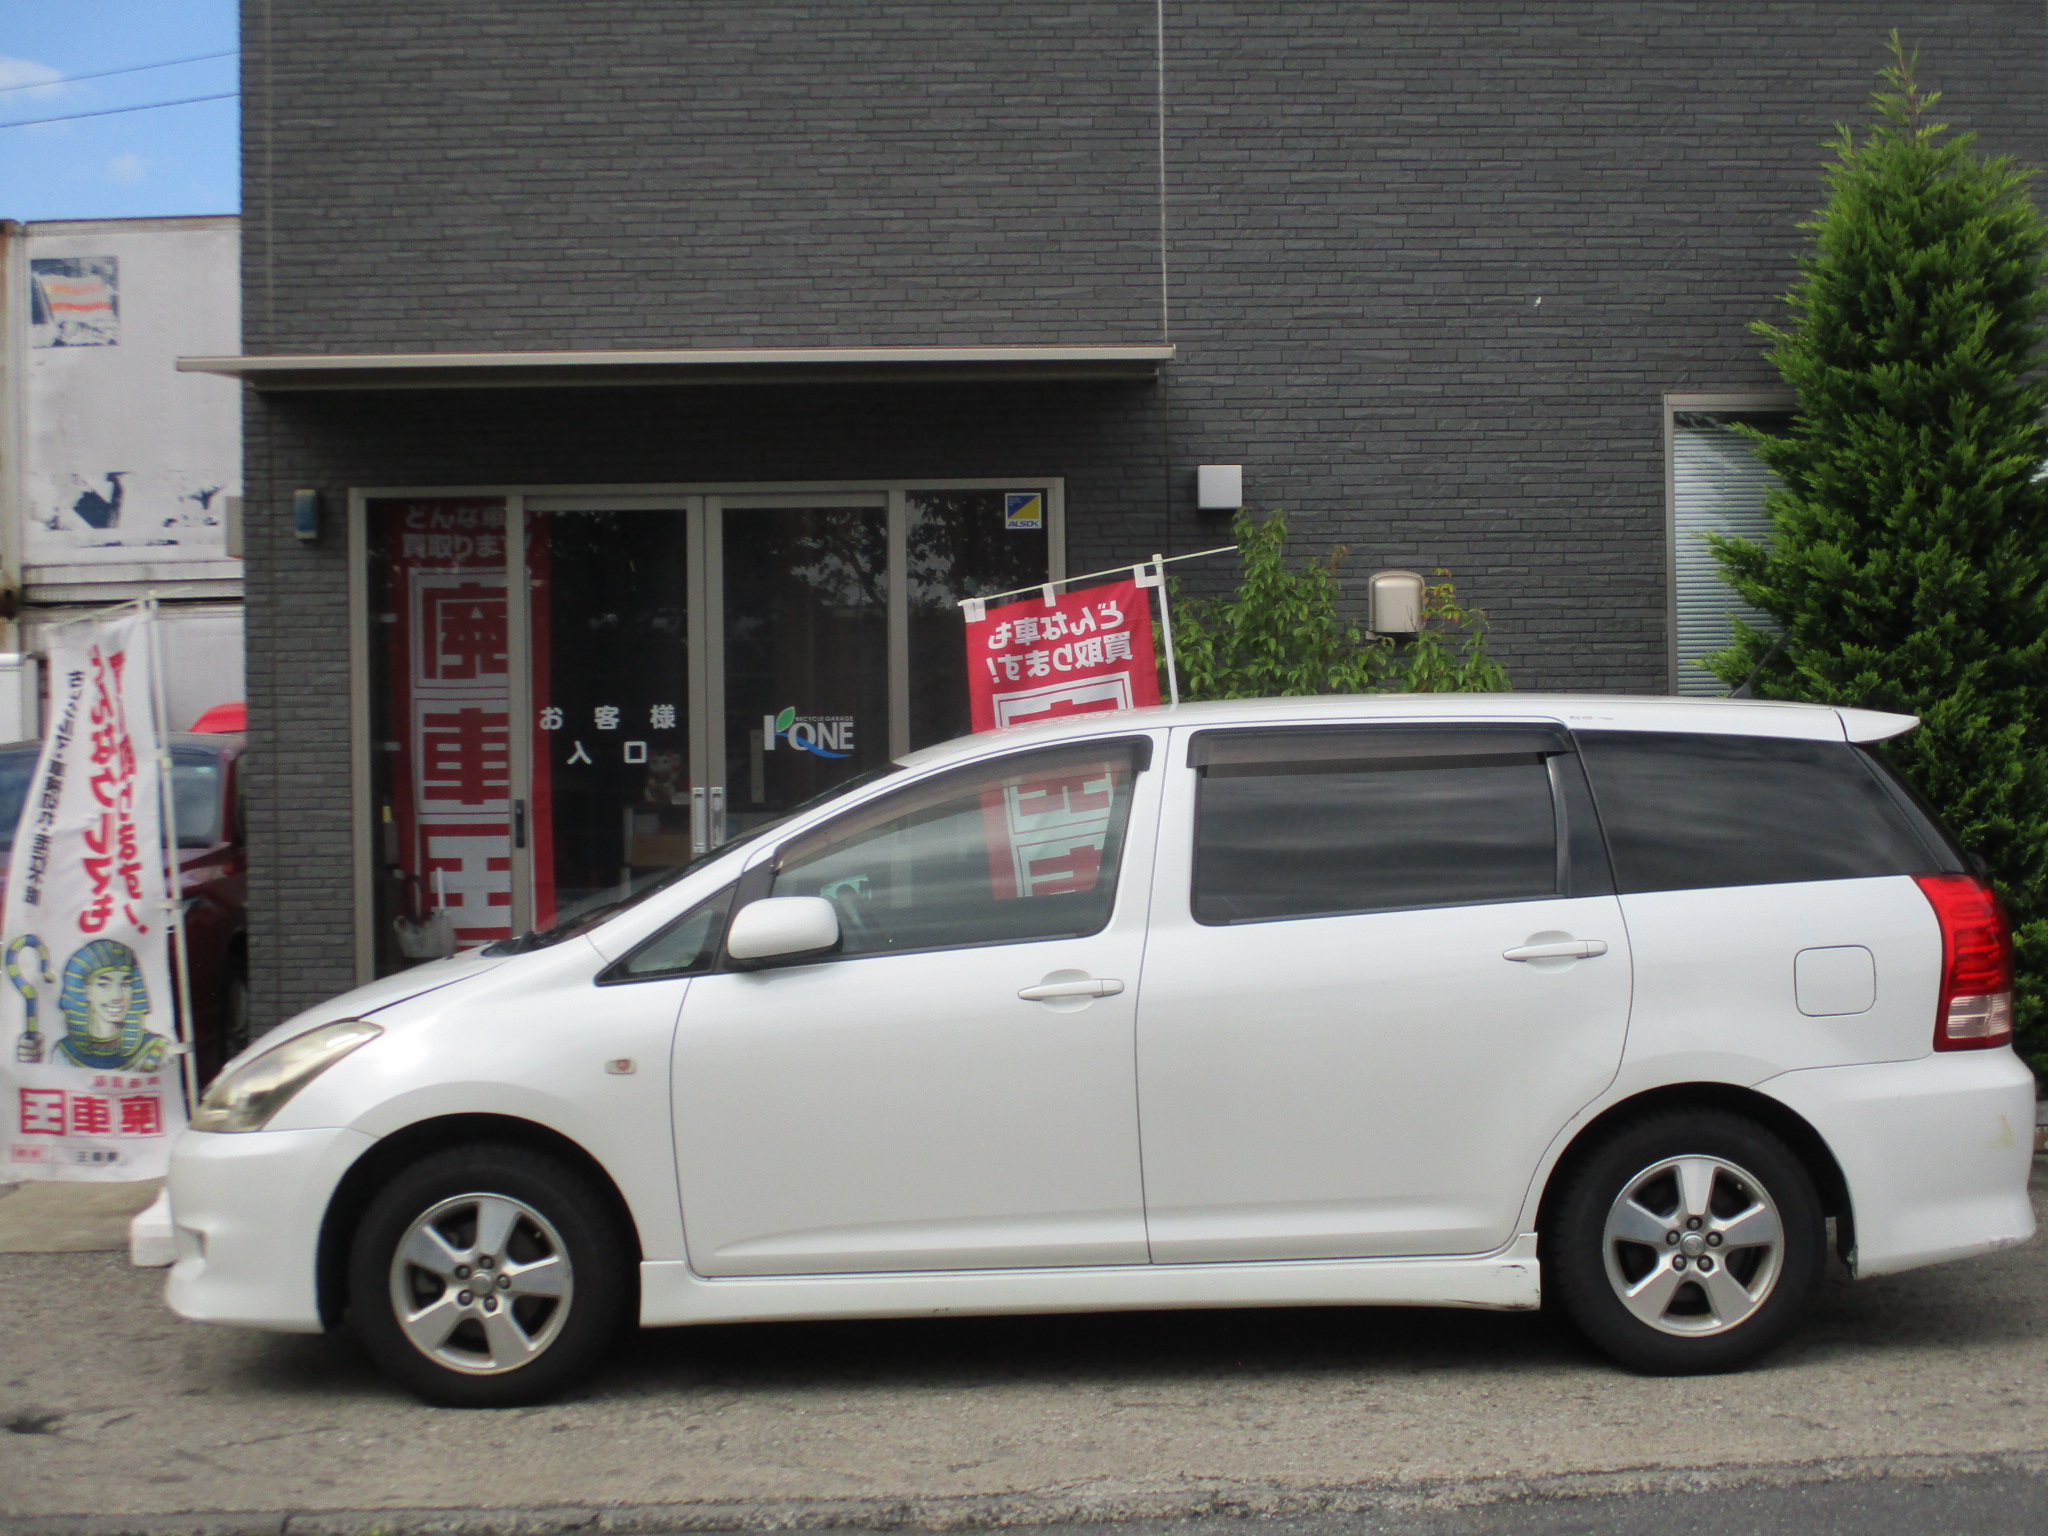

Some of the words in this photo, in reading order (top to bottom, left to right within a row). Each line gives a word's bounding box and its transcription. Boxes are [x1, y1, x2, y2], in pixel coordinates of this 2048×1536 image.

[1008, 519, 1039, 528] ALSOK
[539, 704, 677, 731] お客様
[566, 740, 648, 765] 入口
